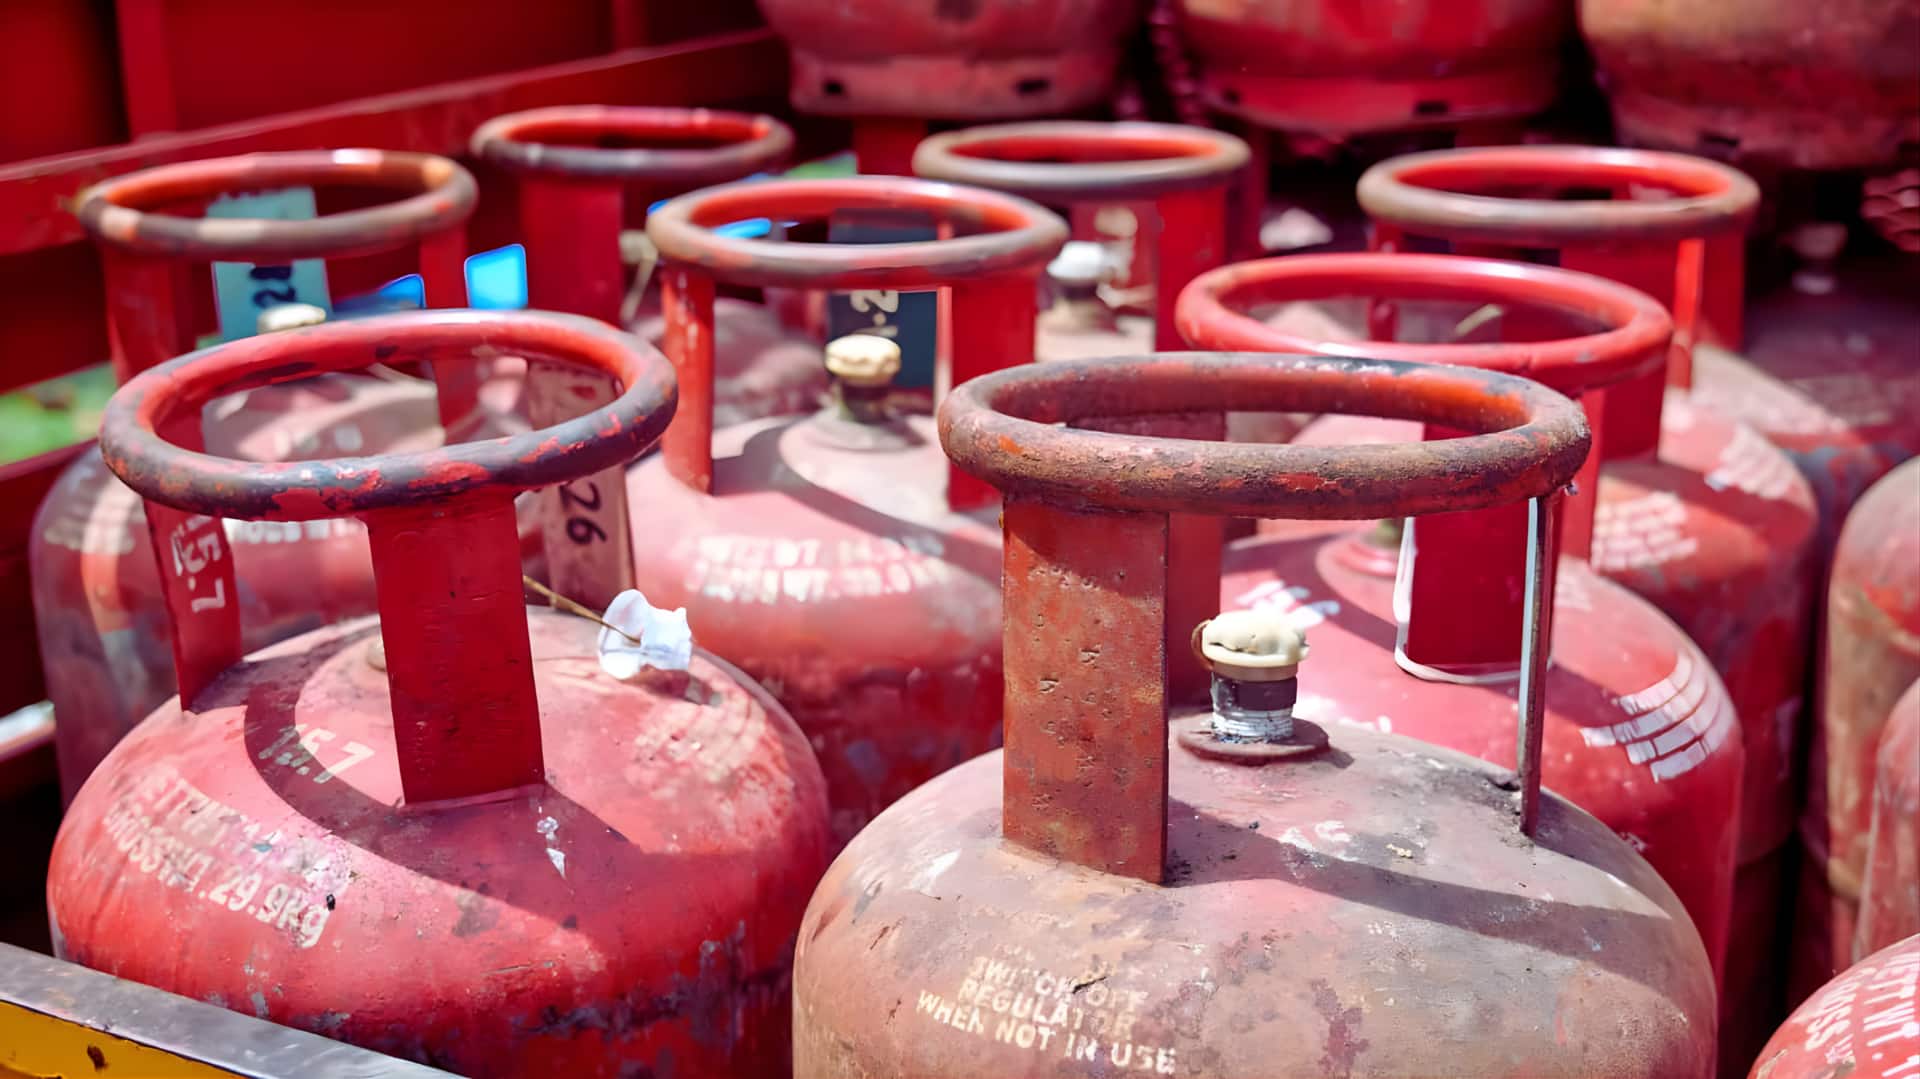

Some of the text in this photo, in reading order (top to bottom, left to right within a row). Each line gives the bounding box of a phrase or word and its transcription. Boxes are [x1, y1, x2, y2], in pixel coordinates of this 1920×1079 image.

[258, 723, 376, 784] 15.7
[916, 990, 1177, 1075] WHEN NOT IN USE
